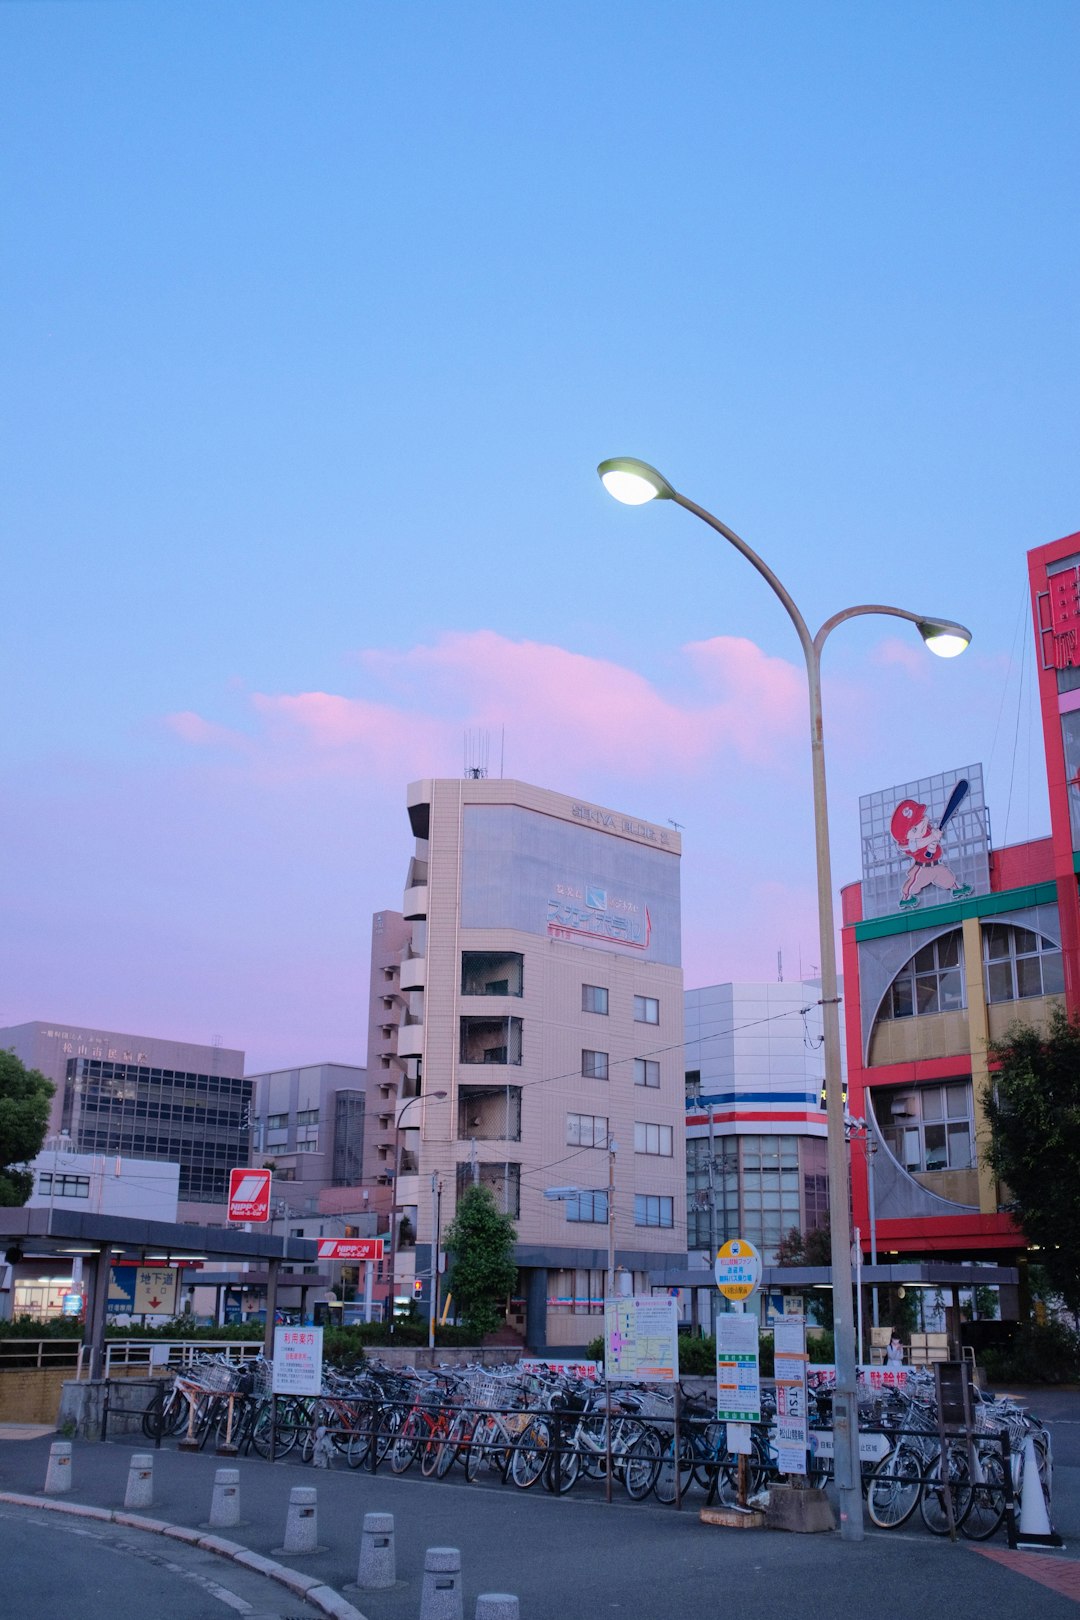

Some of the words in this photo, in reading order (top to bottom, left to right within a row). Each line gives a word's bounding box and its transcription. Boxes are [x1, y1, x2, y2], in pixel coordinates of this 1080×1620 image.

[63, 1042, 148, 1064] 松山市民病院
[231, 1203, 267, 1212] NIPPON
[337, 1245, 370, 1253] NIPPON
[140, 1272, 174, 1286] 地下道
[284, 1333, 315, 1348] 利用案内
[789, 1386, 799, 1417] TSU
[779, 1428, 804, 1441] 松山競輪
